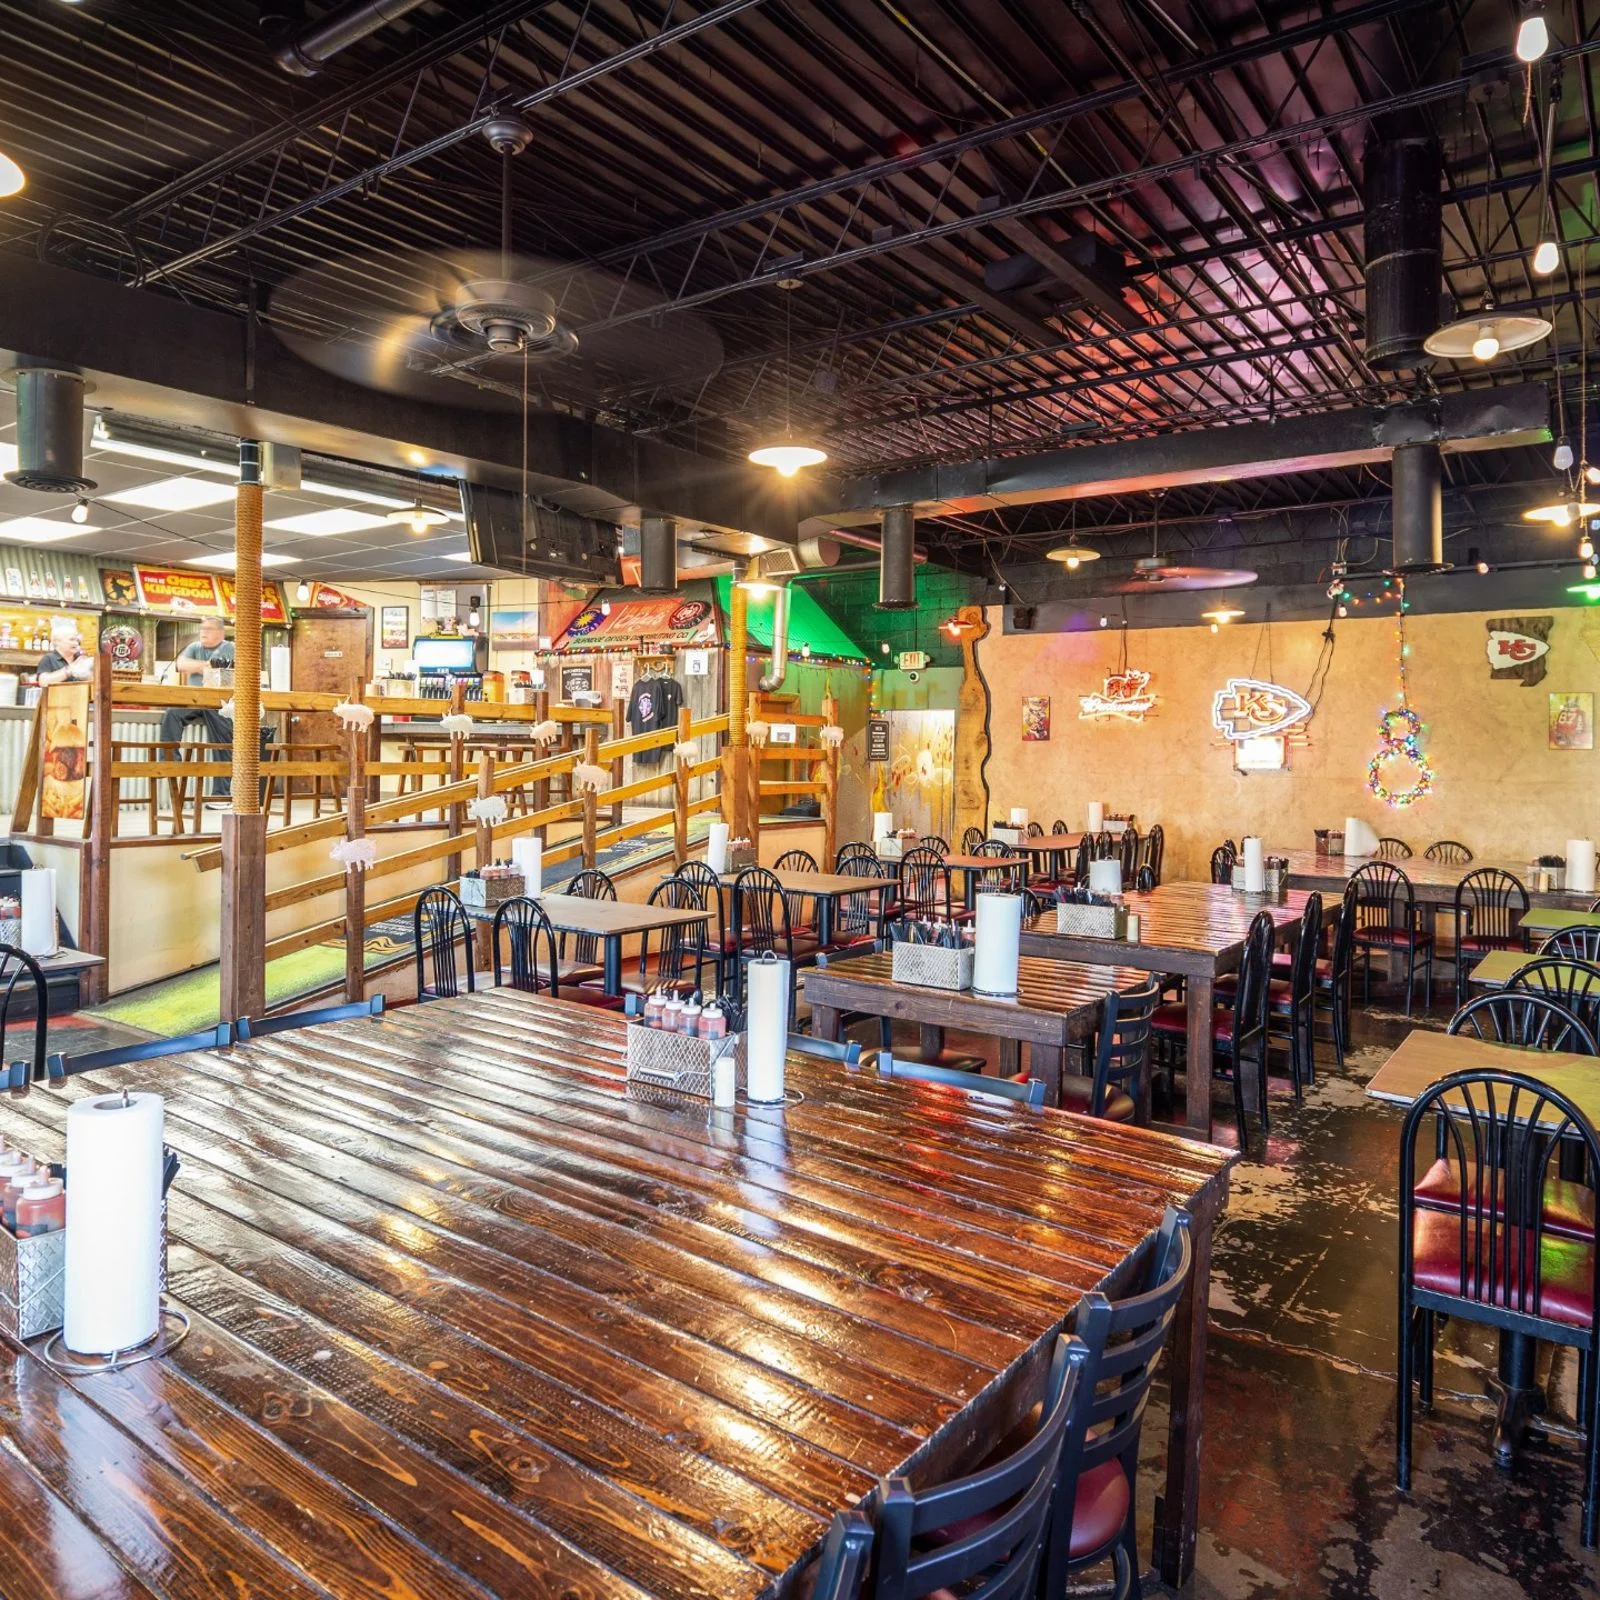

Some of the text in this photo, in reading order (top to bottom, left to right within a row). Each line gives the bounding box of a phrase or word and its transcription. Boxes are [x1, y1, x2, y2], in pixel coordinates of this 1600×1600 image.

[166, 575, 210, 589] CHIEFS
[144, 583, 214, 599] KINGDOM
[1498, 639, 1537, 661] KC
[904, 652, 920, 665] EXIT
[1559, 712, 1576, 725] 87
